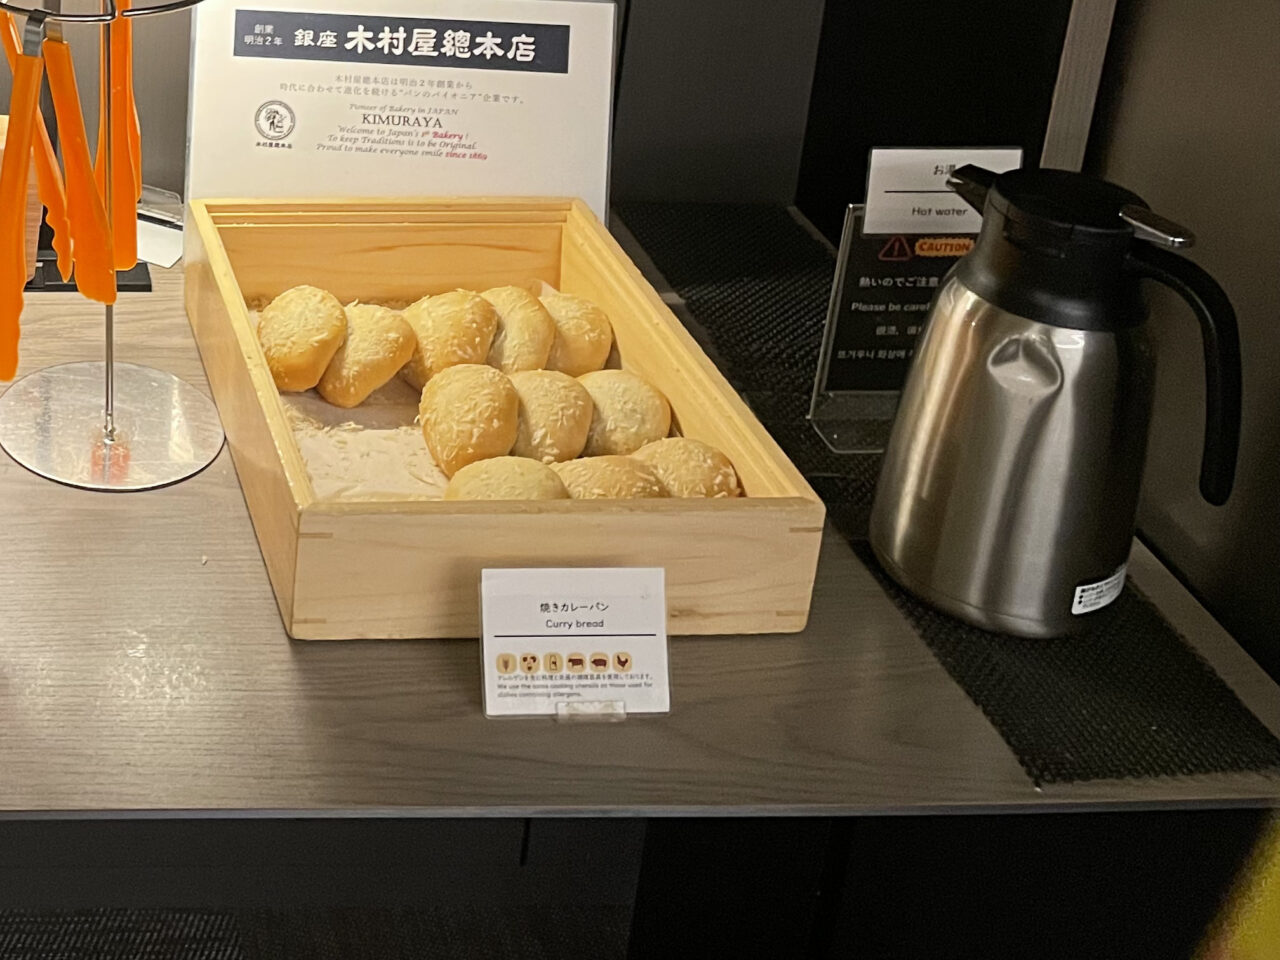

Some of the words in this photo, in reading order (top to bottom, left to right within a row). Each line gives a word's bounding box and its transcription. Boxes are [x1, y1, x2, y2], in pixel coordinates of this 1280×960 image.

[294, 28, 338, 48] 銀座
[344, 24, 536, 62] 木村屋總本店
[362, 113, 443, 129] KIMURAYA
[338, 125, 374, 135] Welcome
[432, 131, 464, 142] Bakery
[328, 134, 337, 142] To
[340, 136, 358, 145] keep
[361, 136, 405, 145] Traditions
[416, 139, 425, 147] to
[427, 139, 437, 147] be
[317, 143, 342, 151] Proud
[355, 145, 378, 153] make
[380, 148, 419, 158] everyone
[445, 151, 466, 159] since
[911, 206, 934, 217] Hot
[937, 207, 969, 217] water
[919, 241, 970, 253] CAUTION
[851, 302, 886, 312] Please
[888, 302, 901, 311] be
[540, 602, 609, 613] 焼きカレーパン
[546, 620, 573, 630] Curry
[576, 620, 604, 628] bread
